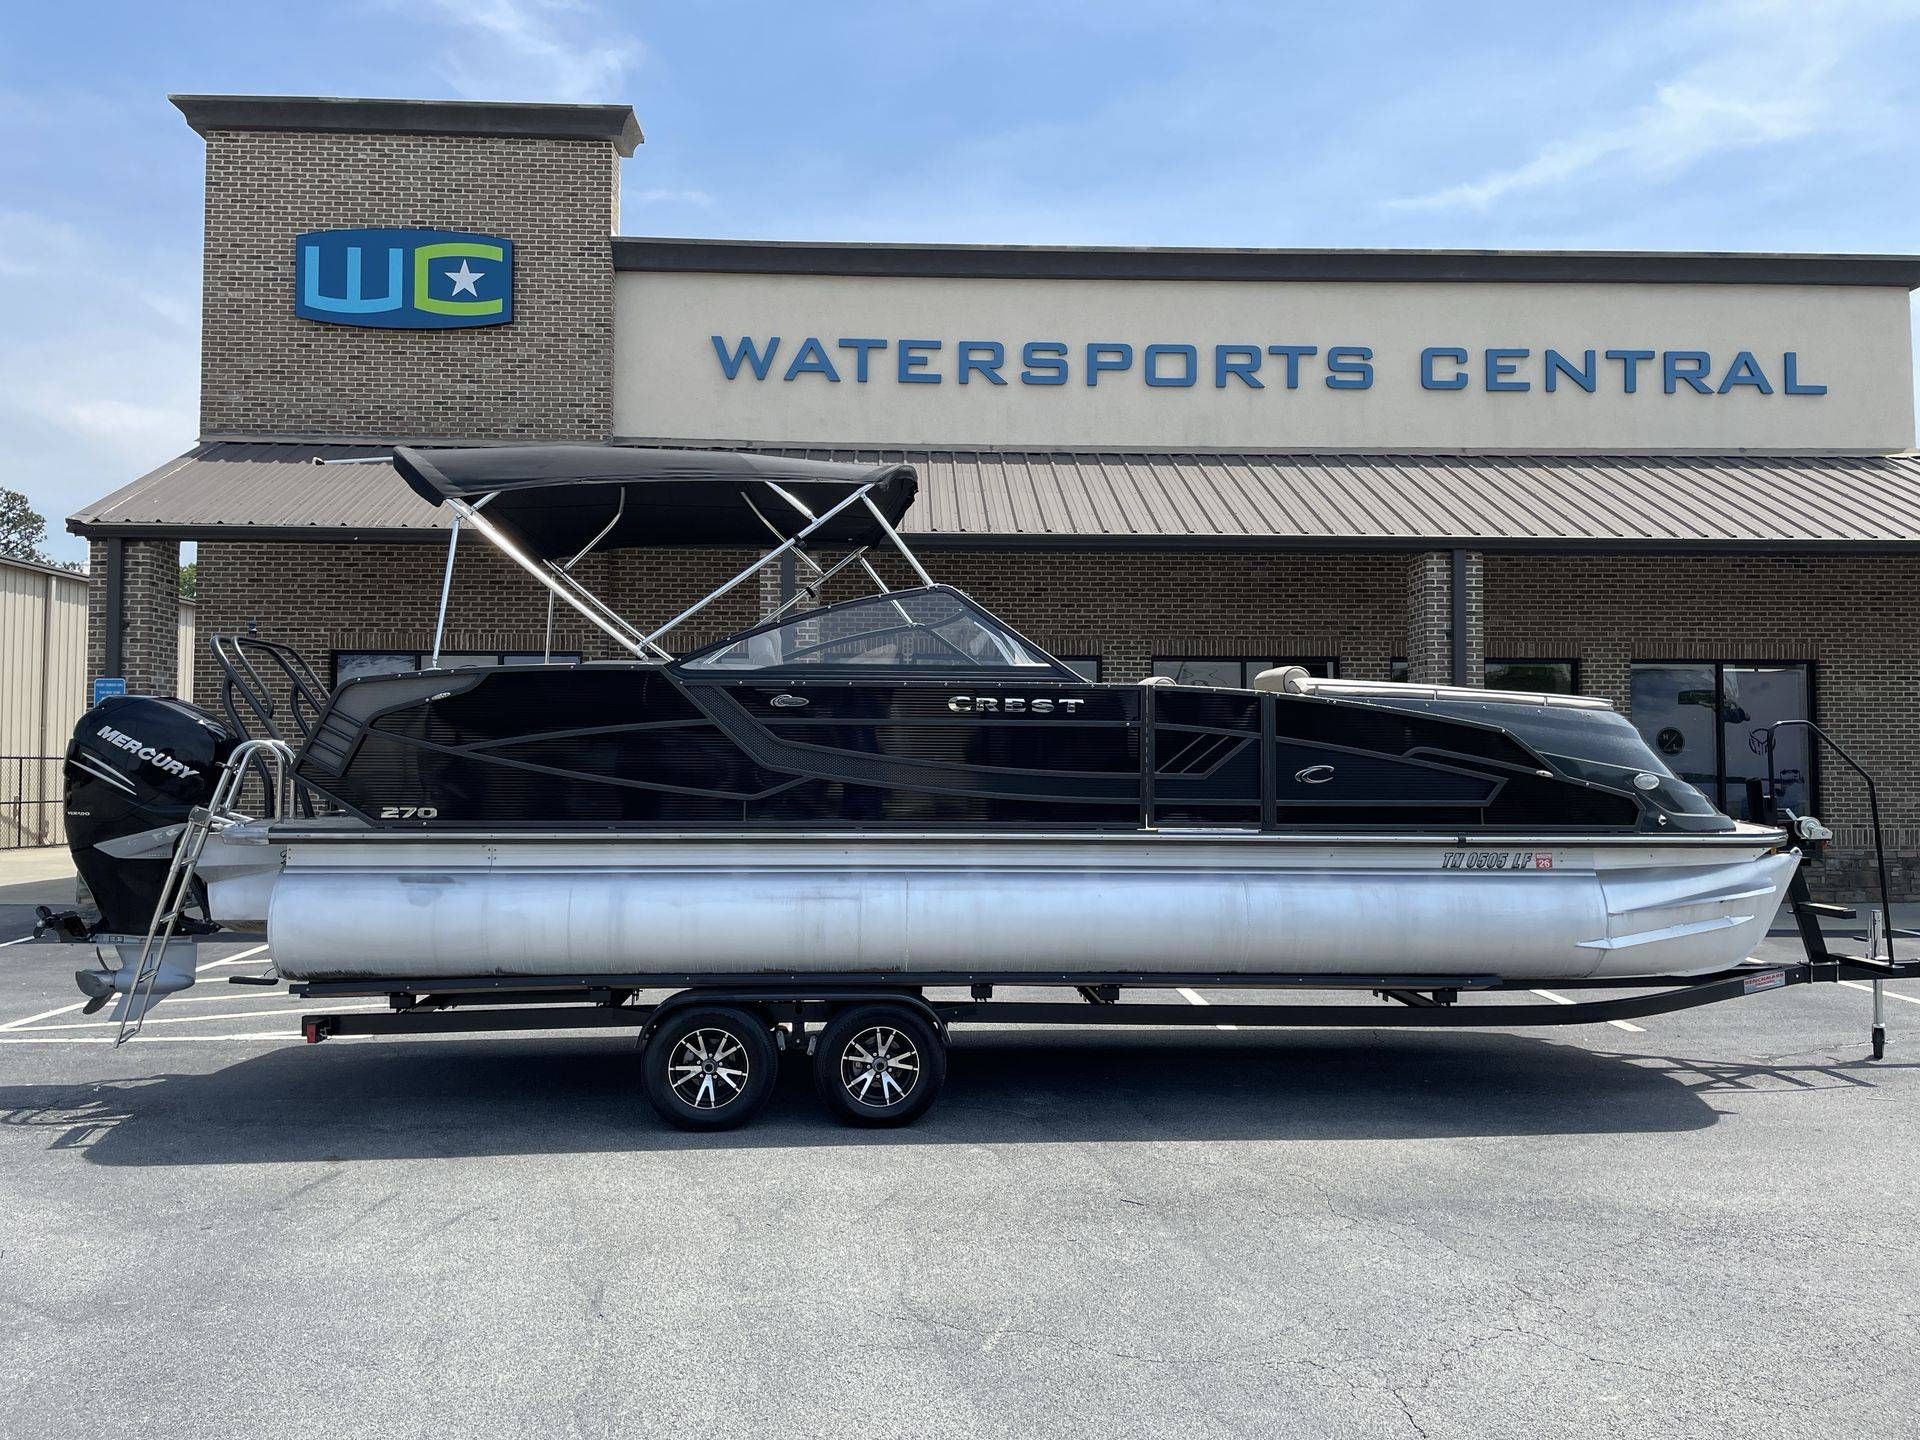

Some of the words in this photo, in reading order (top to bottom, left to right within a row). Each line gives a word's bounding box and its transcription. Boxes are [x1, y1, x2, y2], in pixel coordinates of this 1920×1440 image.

[711, 335, 1373, 390] WATERSPORTS
[1420, 347, 1828, 395] CENTRAL
[948, 696, 1085, 713] CREST
[96, 725, 200, 779] MERCURY
[381, 807, 438, 819] 270
[1441, 853, 1465, 869] TN
[1466, 852, 1509, 869] 0505
[1511, 853, 1533, 869] LF
[1538, 859, 1550, 868] 26
